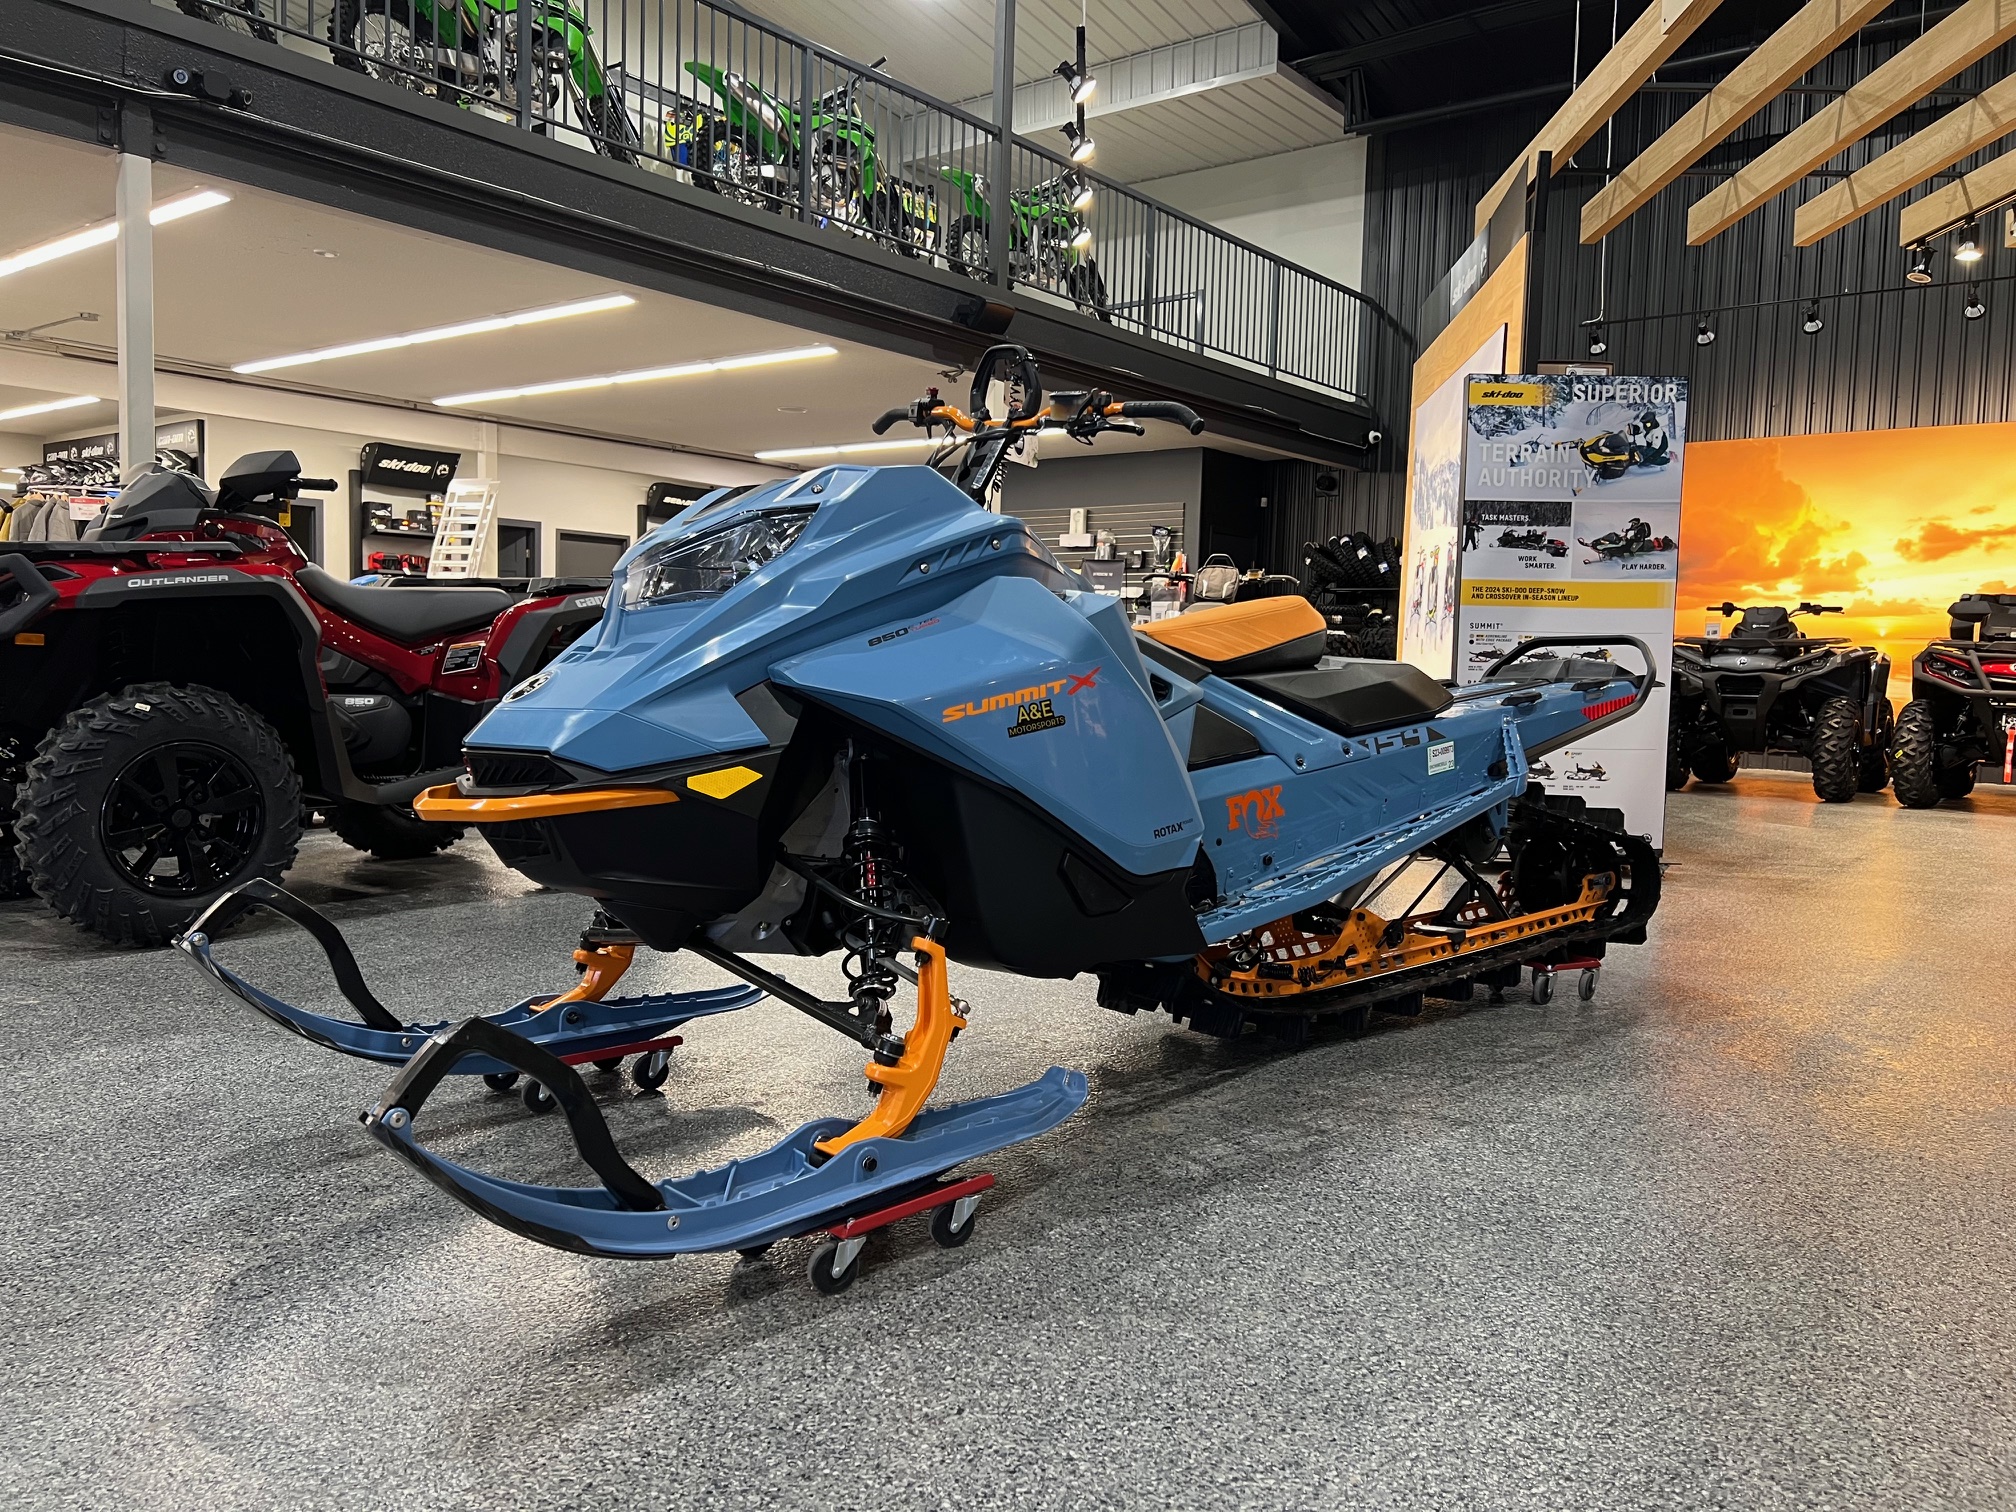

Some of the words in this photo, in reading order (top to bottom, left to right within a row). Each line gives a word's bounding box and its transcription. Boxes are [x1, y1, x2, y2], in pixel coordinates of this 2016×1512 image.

[1481, 390, 1525, 399] ski-doo
[1573, 383, 1678, 404] SUPERIOR
[1479, 443, 1571, 463] TERRAIN
[378, 458, 432, 474] ski-doo
[1478, 467, 1597, 489] AUTHORITY
[1481, 513, 1498, 521] TASK
[1499, 514, 1531, 522] MASTERS.
[1525, 562, 1557, 570] SMARTER.
[1622, 563, 1638, 571] PLAY
[1639, 563, 1667, 571] HARDER.
[127, 575, 229, 588] OUTLANDER
[867, 627, 909, 647] 850
[345, 697, 375, 705] 850
[942, 679, 1067, 723] SUMMIT
[1067, 666, 1102, 696] X
[1018, 701, 1053, 723] A&E
[1009, 717, 1065, 736] MOTORSPORTS
[1365, 726, 1430, 755] 159
[1226, 784, 1285, 837] FOX
[1153, 821, 1184, 839] ROTAX
